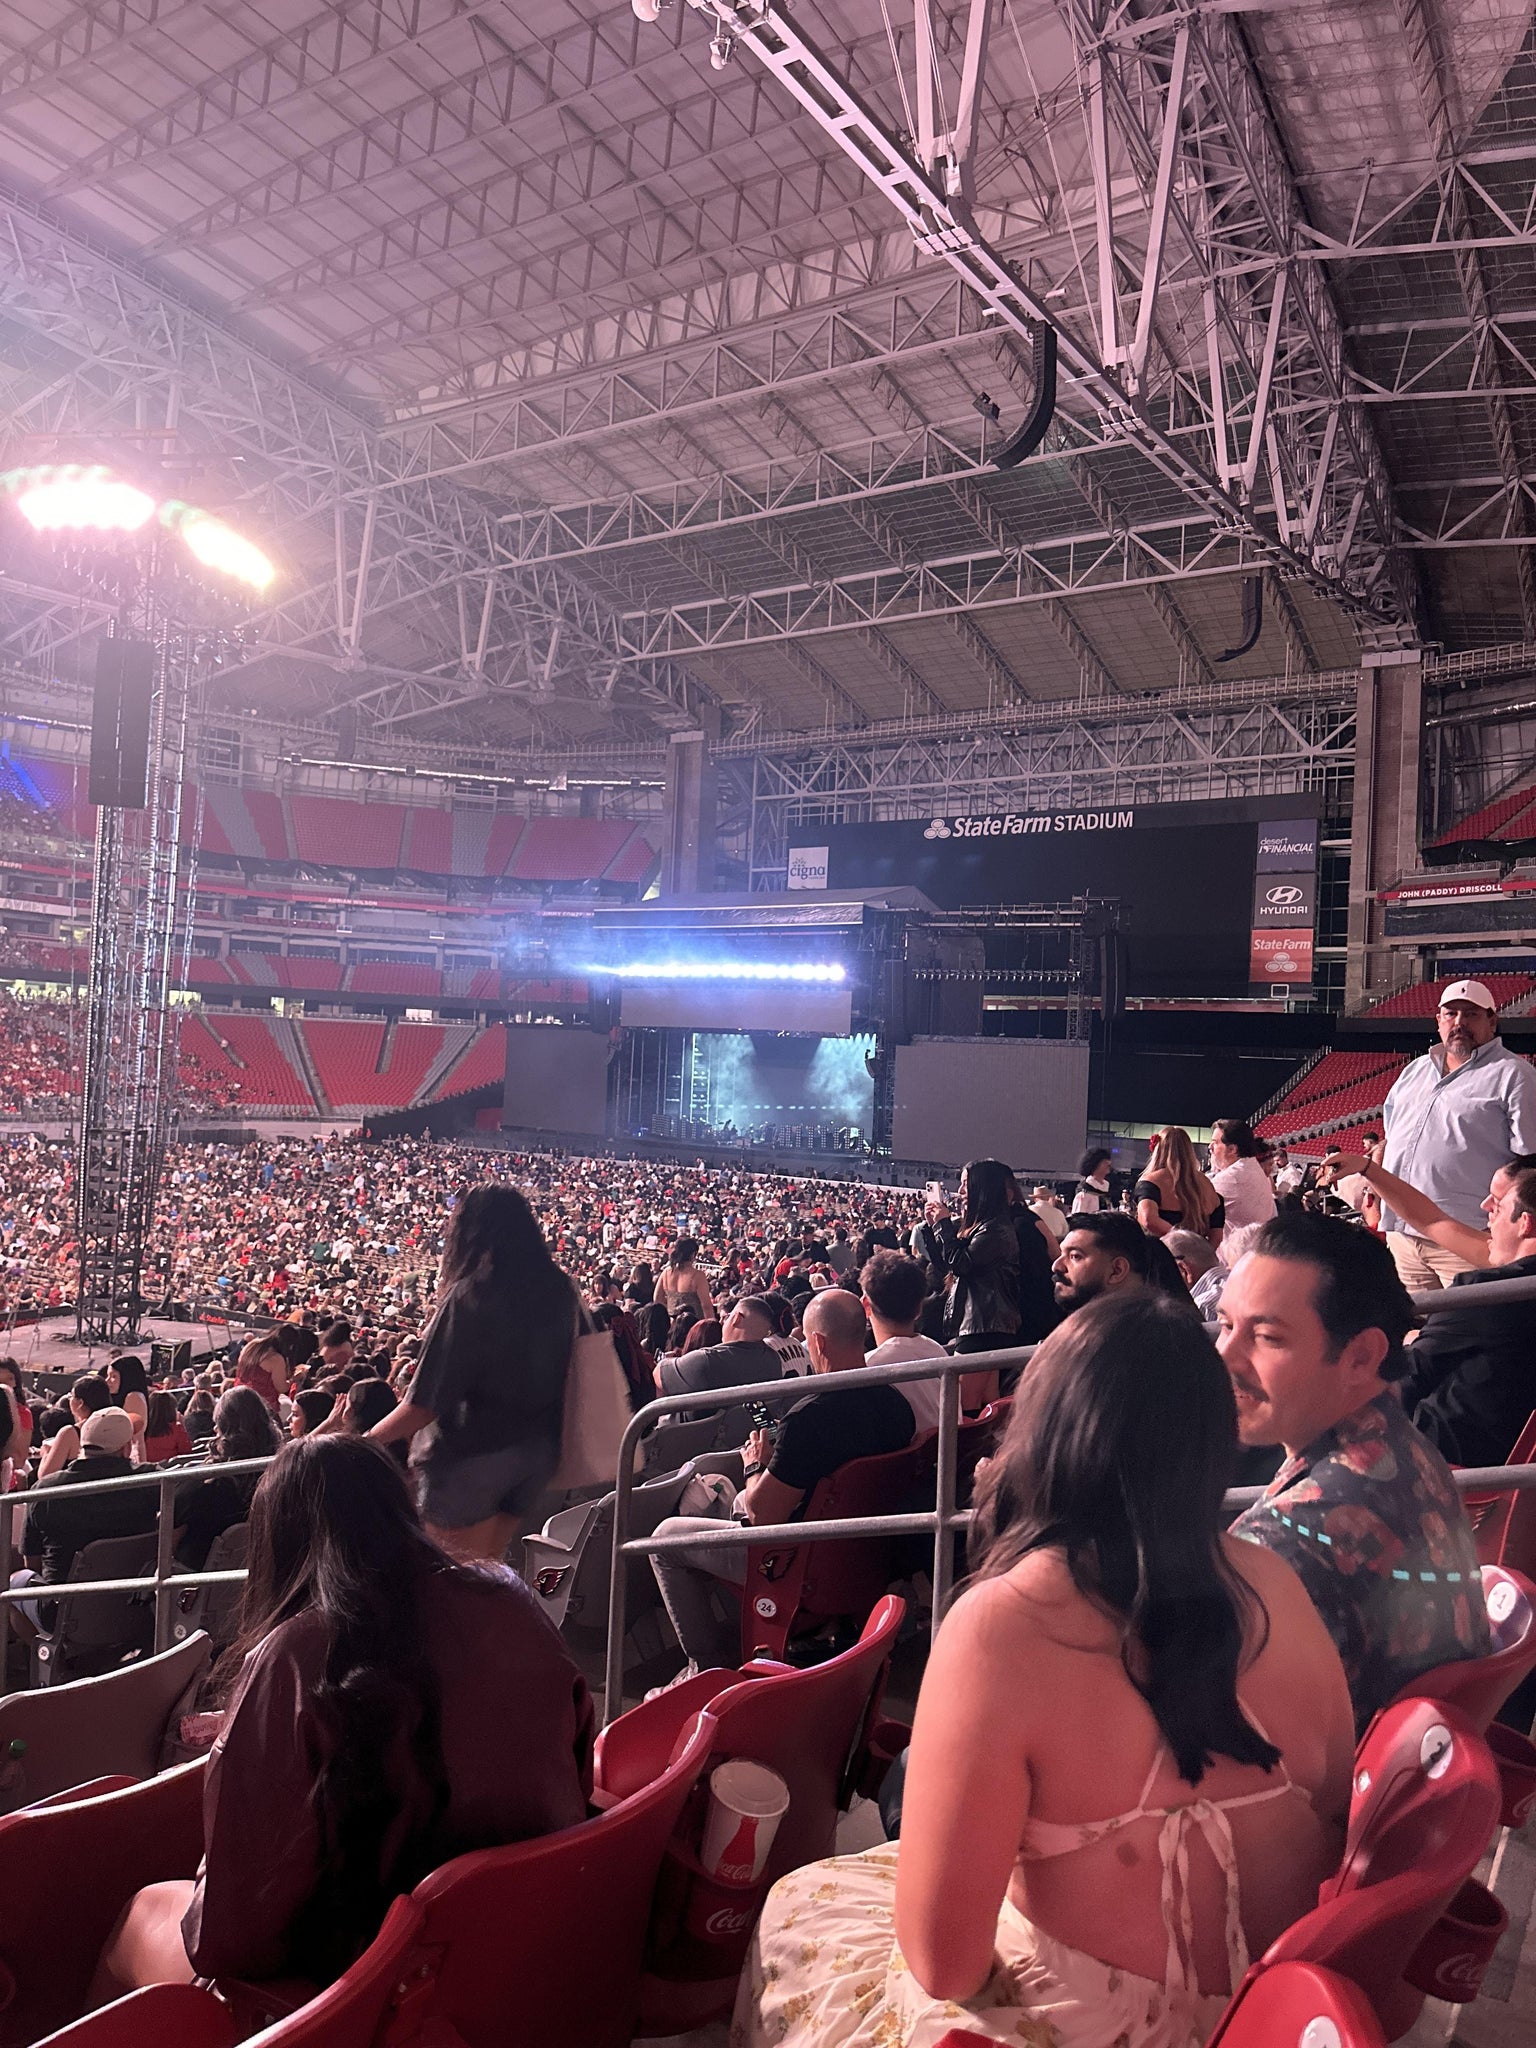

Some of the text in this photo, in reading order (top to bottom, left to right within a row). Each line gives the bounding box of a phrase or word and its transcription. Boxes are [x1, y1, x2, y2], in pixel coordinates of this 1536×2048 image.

[1054, 811, 1133, 832] STADIUM
[1260, 837, 1288, 845] desert
[790, 866, 826, 880] cigna
[1398, 884, 1503, 898] JOHN (PADDY) DRISCOLL
[1260, 906, 1308, 915] HYUNDAI
[160, 1257, 168, 1268] F
[760, 1602, 772, 1613] 24
